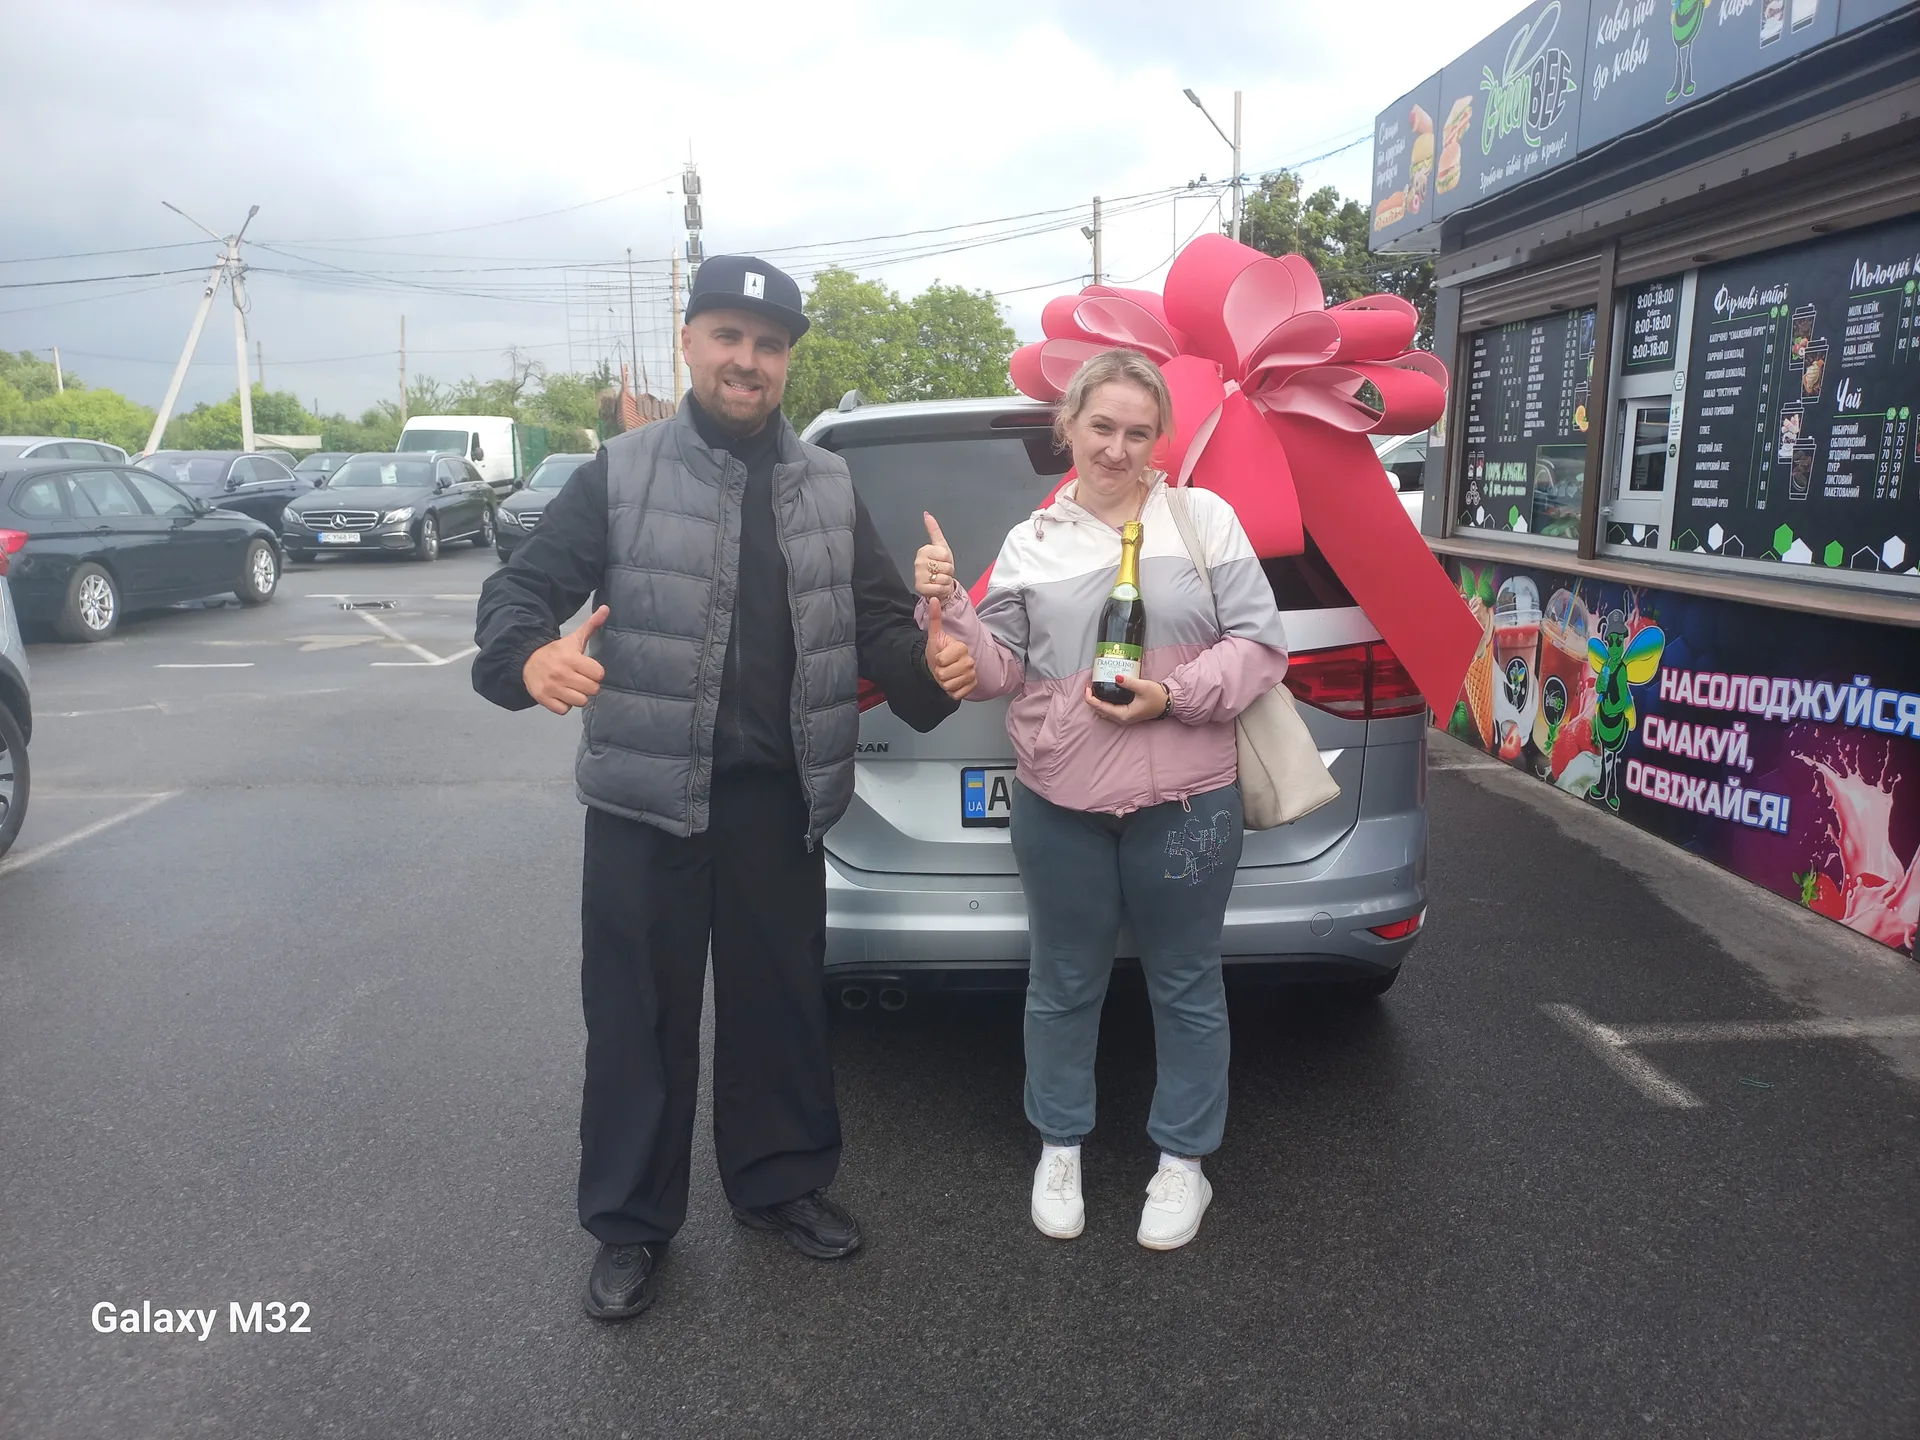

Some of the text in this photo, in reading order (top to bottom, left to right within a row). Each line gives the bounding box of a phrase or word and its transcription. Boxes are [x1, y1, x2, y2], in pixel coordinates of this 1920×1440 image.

[1595, 2, 1630, 48] Кава
[1613, 30, 1650, 82] кави
[1850, 257, 1911, 290] Молочні
[1637, 288, 1674, 309] 9:00-18:00
[1714, 283, 1758, 320] Фірмові
[1760, 283, 1789, 305] напої
[1904, 297, 1911, 307] 76
[1635, 314, 1671, 334] 8:00-18:00
[1769, 324, 1775, 334] 99
[1845, 325, 1863, 336] КАКАО
[1901, 318, 1909, 328] 78
[1633, 340, 1669, 359] 9:00-18:00
[1898, 338, 1906, 349] 82
[1836, 377, 1862, 412] Чай
[1885, 423, 1893, 433] 70
[1897, 422, 1906, 433] 75
[1883, 436, 1891, 446] 70
[1895, 436, 1904, 446] 75
[1881, 449, 1890, 459] 70
[1894, 449, 1902, 460] 75
[1879, 462, 1888, 472] 55
[1892, 462, 1900, 473] 59
[1825, 473, 1899, 486] ЛИСТОВИЙ 47 49
[1824, 486, 1897, 499] ПАКЕТОВАНИЙ 37 40
[1660, 667, 1920, 737] НАСОЛОДЖУЙСЯ
[1642, 716, 1754, 773] СМАКУЙ,
[1626, 761, 1791, 833] ОСВІЖАЙСЯ!
[968, 801, 984, 812] UA
